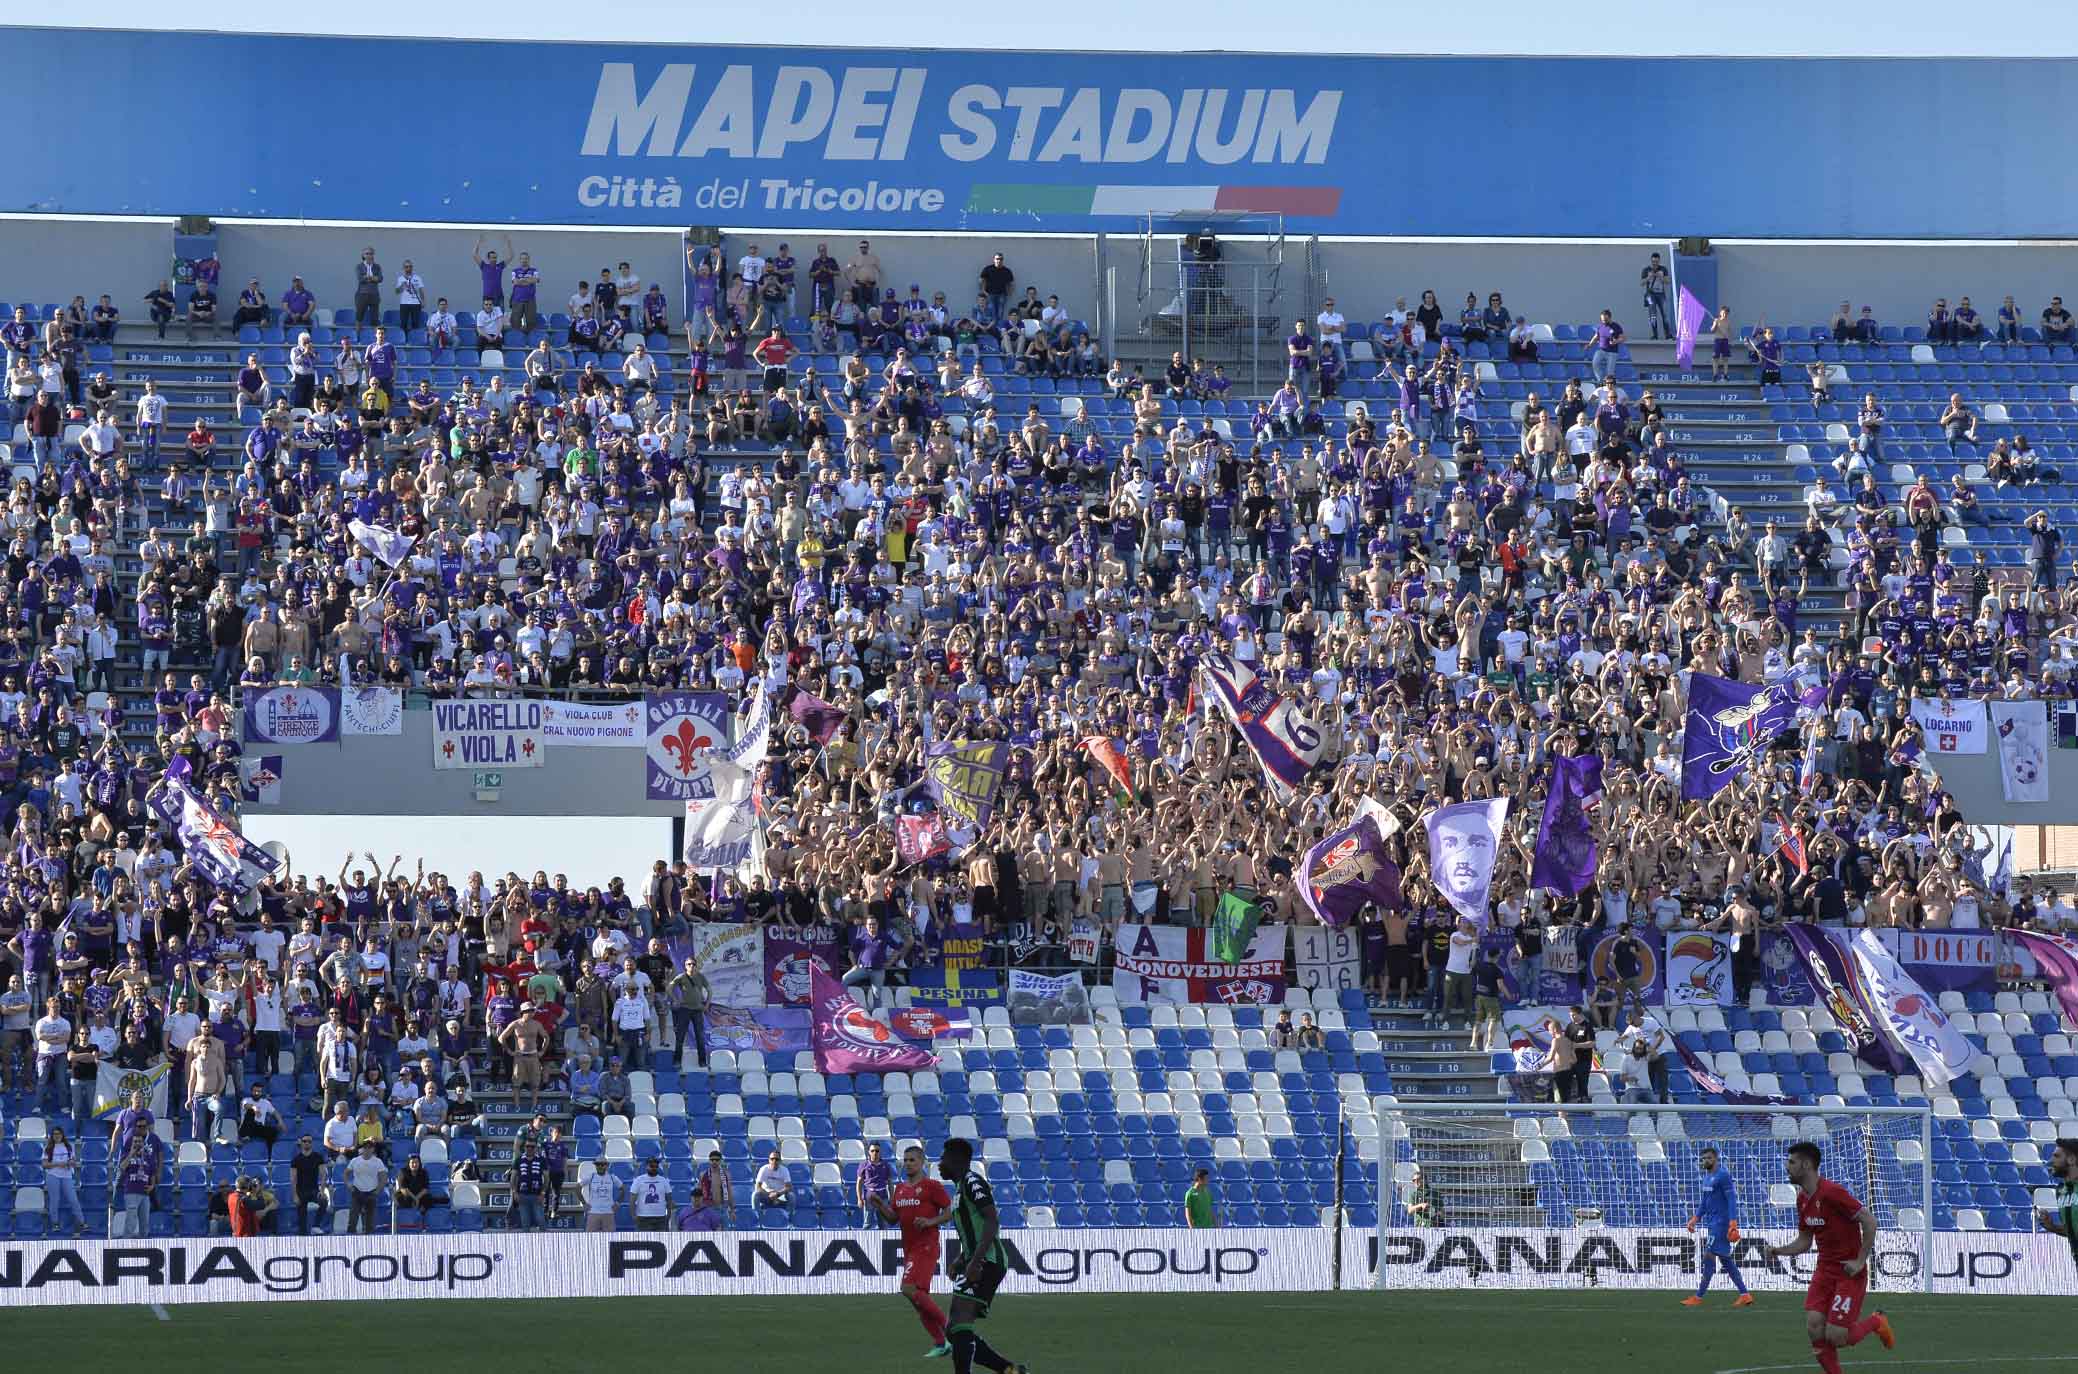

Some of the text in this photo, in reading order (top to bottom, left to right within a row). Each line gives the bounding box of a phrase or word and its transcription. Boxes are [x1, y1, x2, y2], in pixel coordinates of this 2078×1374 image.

[580, 61, 1344, 166] MAPEI STADIUM
[576, 173, 945, 214] Città del Tricolore
[436, 703, 541, 731] VICARELLO
[565, 710, 613, 720] VIOLA CLUB
[649, 697, 724, 724] QUELLI
[277, 720, 320, 729] FIRENZE
[543, 725, 634, 737] CRAL NUOVO PIGNONE
[1924, 717, 1973, 732] LOCARNO
[460, 734, 518, 763] VIOLA
[768, 924, 838, 945] CICLONE
[1132, 926, 1160, 957] A
[1913, 935, 1991, 964] DOCG
[1115, 951, 1283, 979] UNONOVEDUESEI
[1400, 1064, 1411, 1072] 10
[1447, 1064, 1459, 1072] 10
[495, 1104, 507, 1113] 08
[497, 1127, 509, 1135] 07
[499, 1151, 511, 1159] 06
[1831, 1295, 1851, 1314] 24
